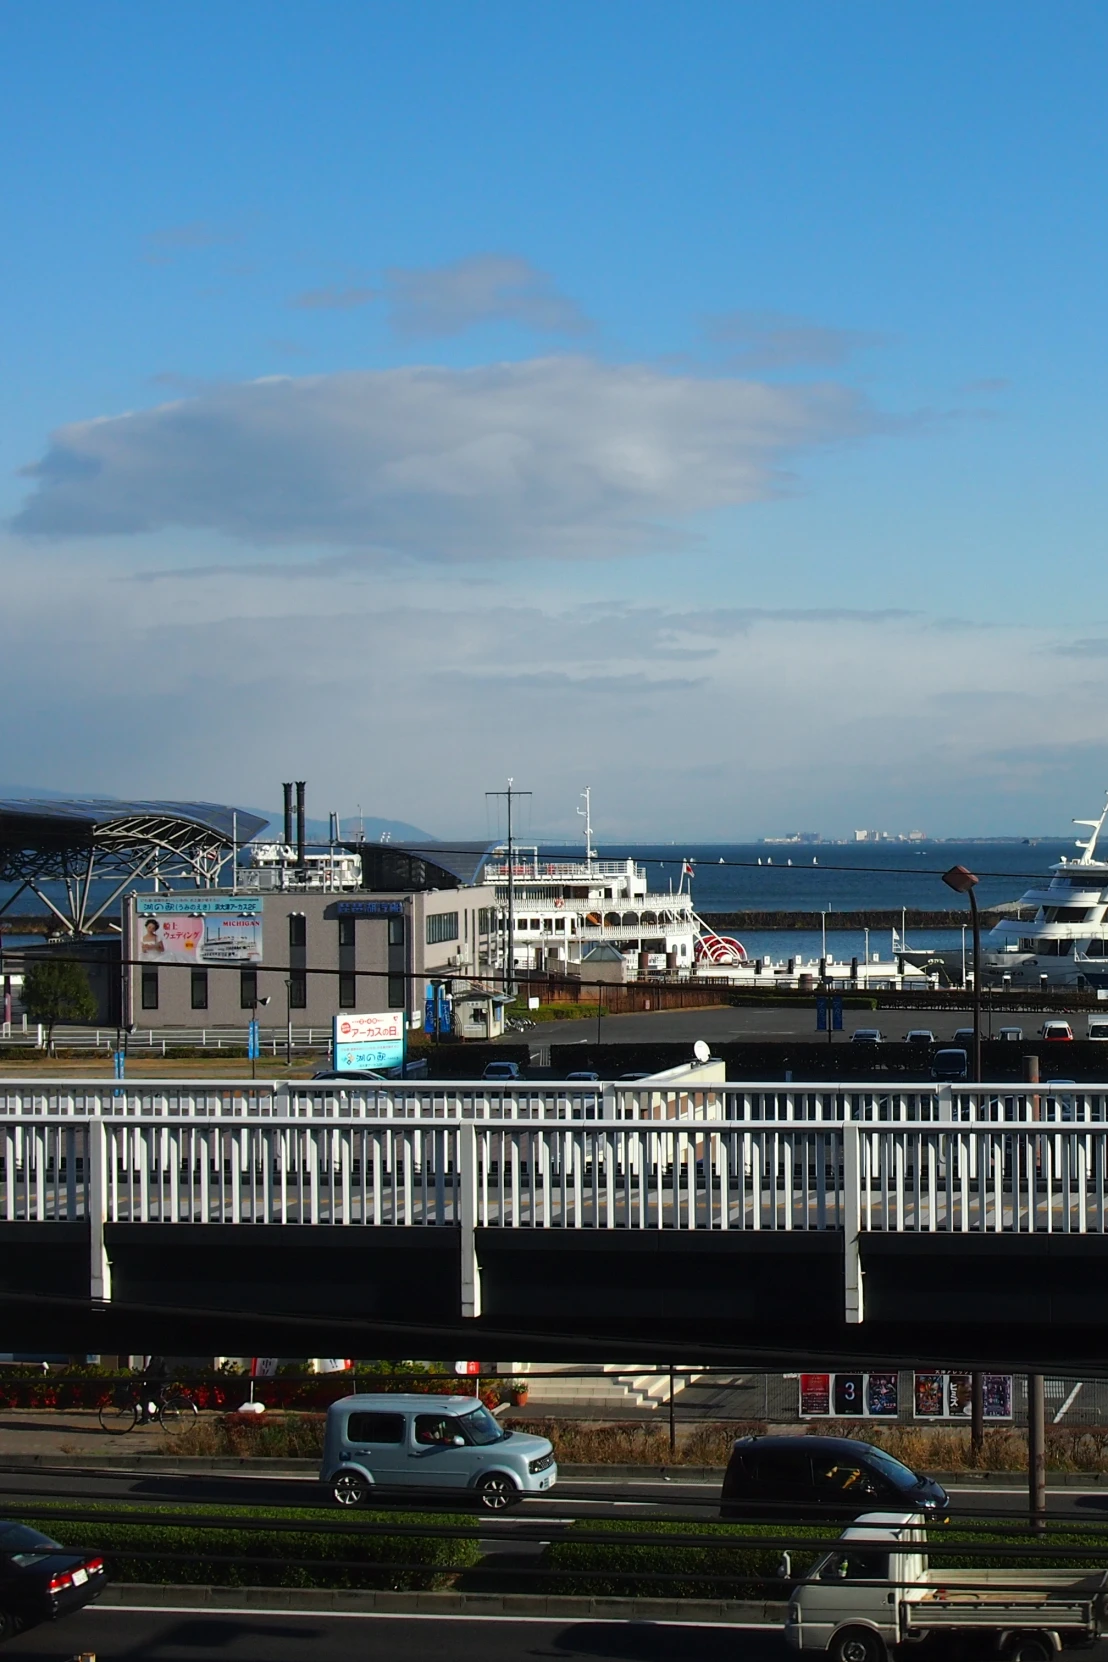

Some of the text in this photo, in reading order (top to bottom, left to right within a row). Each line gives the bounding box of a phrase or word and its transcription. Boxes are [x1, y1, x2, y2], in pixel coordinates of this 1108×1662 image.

[163, 932, 200, 940] ウェディング
[844, 1382, 856, 1400] 3
